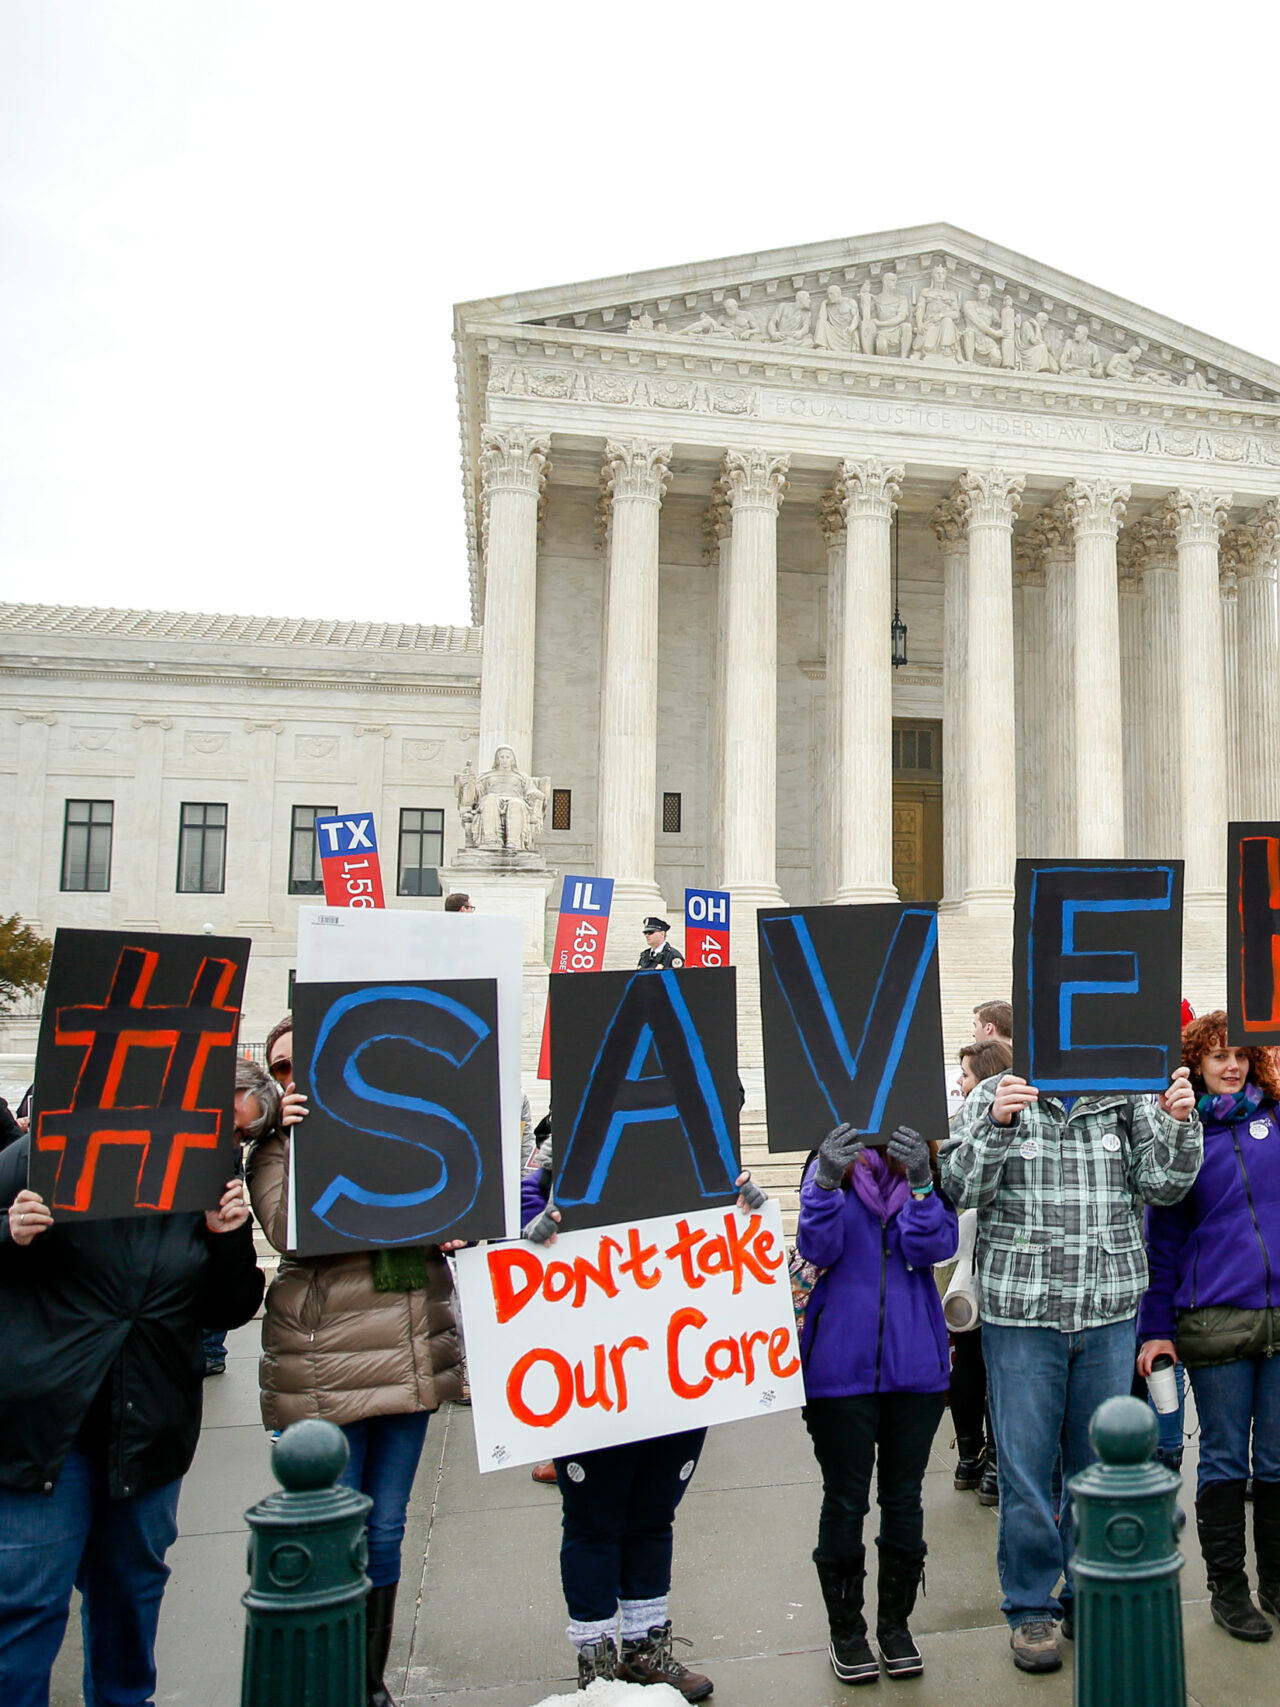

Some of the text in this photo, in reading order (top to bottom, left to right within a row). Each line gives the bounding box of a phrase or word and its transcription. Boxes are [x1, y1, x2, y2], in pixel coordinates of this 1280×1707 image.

[776, 397, 1088, 442] EQUAL JUSTICE UNDER LAW
[320, 819, 374, 851] TX
[572, 882, 600, 910] IL
[688, 896, 726, 923] OH
[701, 935, 722, 967] 49
[665, 1213, 784, 1295] take
[506, 1307, 801, 1428] Our Care
